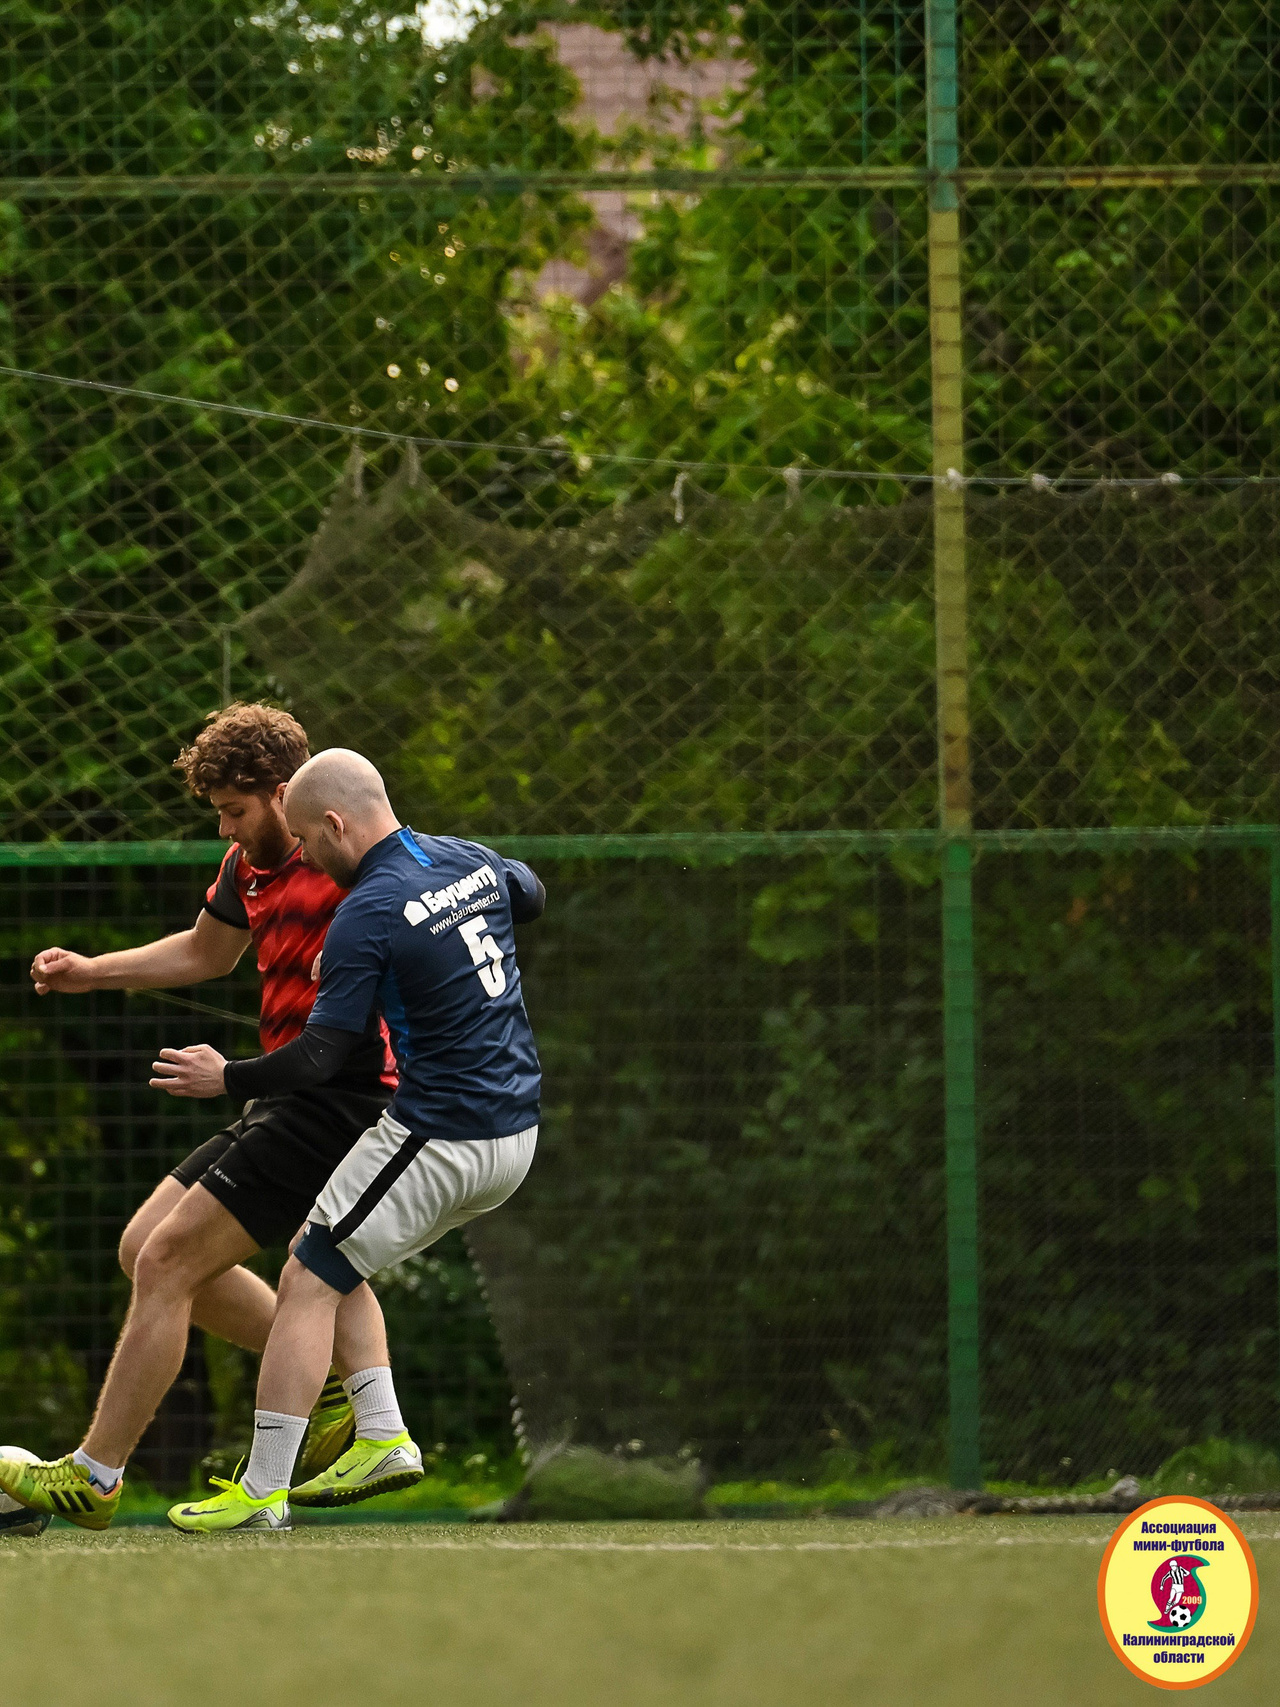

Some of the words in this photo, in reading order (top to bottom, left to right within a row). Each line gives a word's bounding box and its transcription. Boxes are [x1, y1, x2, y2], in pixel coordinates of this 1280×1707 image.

[420, 864, 497, 914] Бауцентр
[429, 890, 500, 935] www.baucenter.ru
[458, 914, 506, 998] 5
